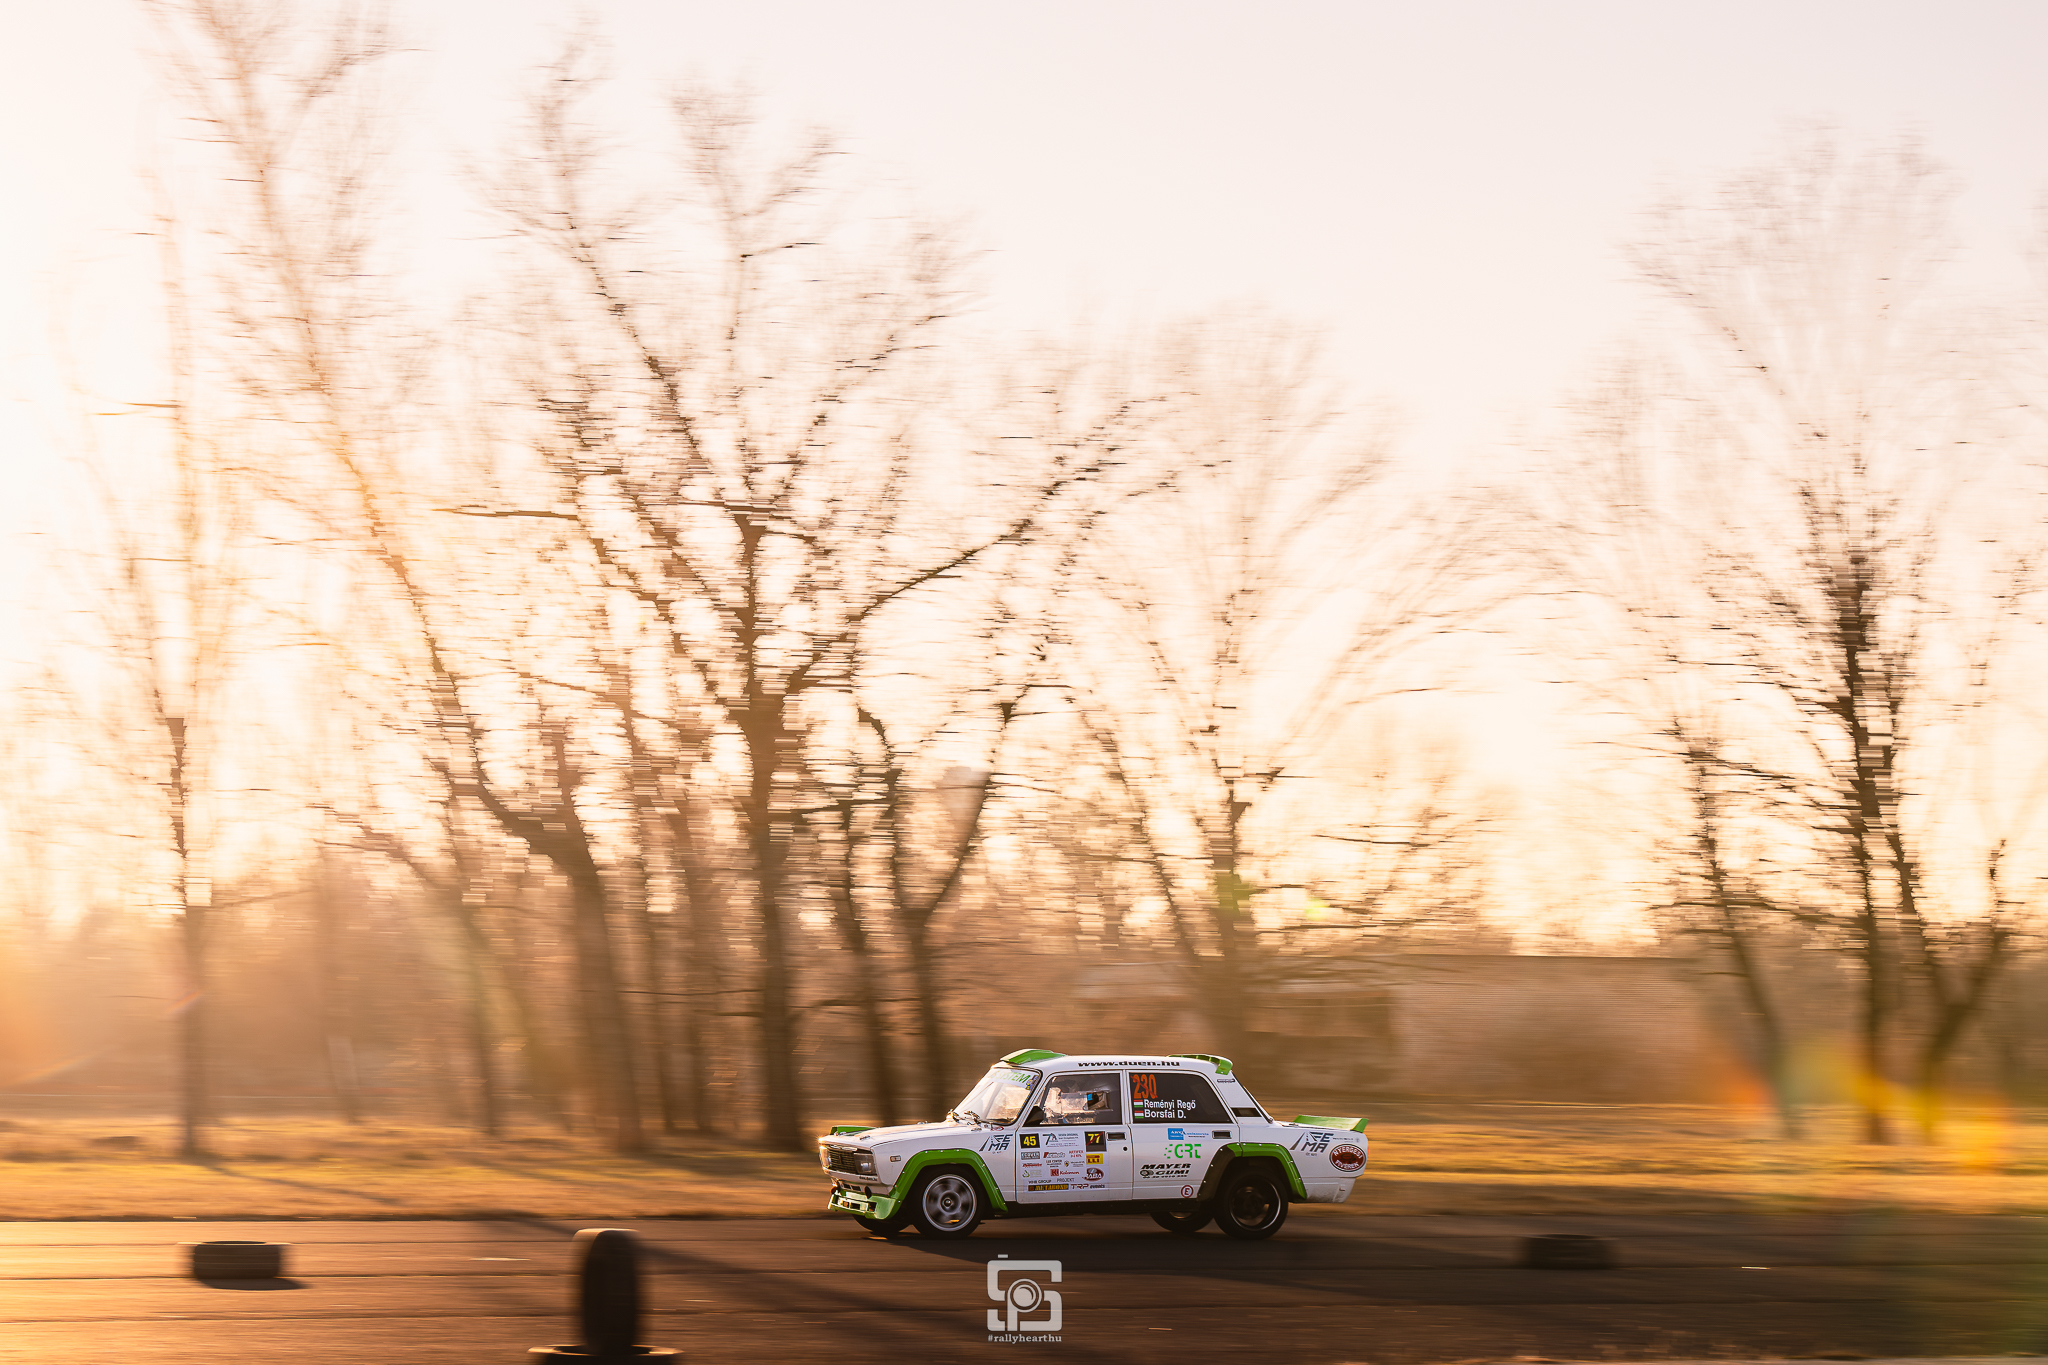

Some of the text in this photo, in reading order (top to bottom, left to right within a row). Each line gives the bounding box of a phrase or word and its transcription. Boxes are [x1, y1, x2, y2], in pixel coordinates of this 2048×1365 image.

[1132, 1074, 1157, 1099] 230
[1144, 1099, 1175, 1110] Reményi
[1144, 1109, 1187, 1119] Borsfai D.
[1023, 1136, 1037, 1146] 45
[1088, 1133, 1101, 1144] 77
